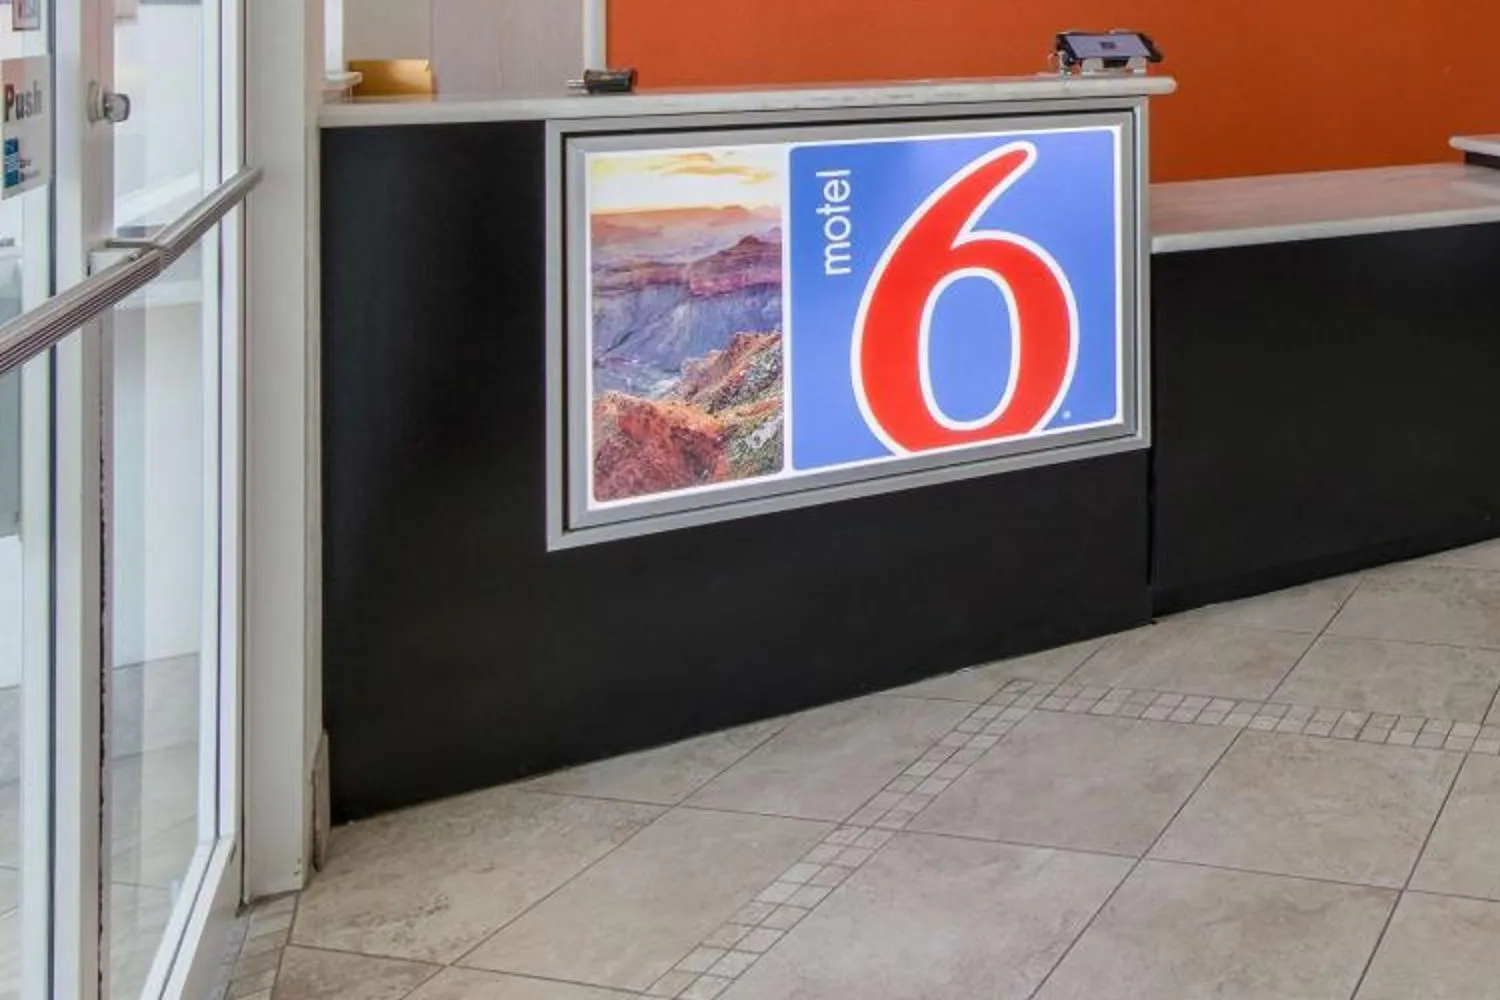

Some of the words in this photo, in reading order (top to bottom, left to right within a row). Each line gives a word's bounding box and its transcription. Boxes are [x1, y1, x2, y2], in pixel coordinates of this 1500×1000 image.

[4, 81, 42, 122] Push
[815, 169, 852, 276] motel
[851, 141, 1080, 456] 6
